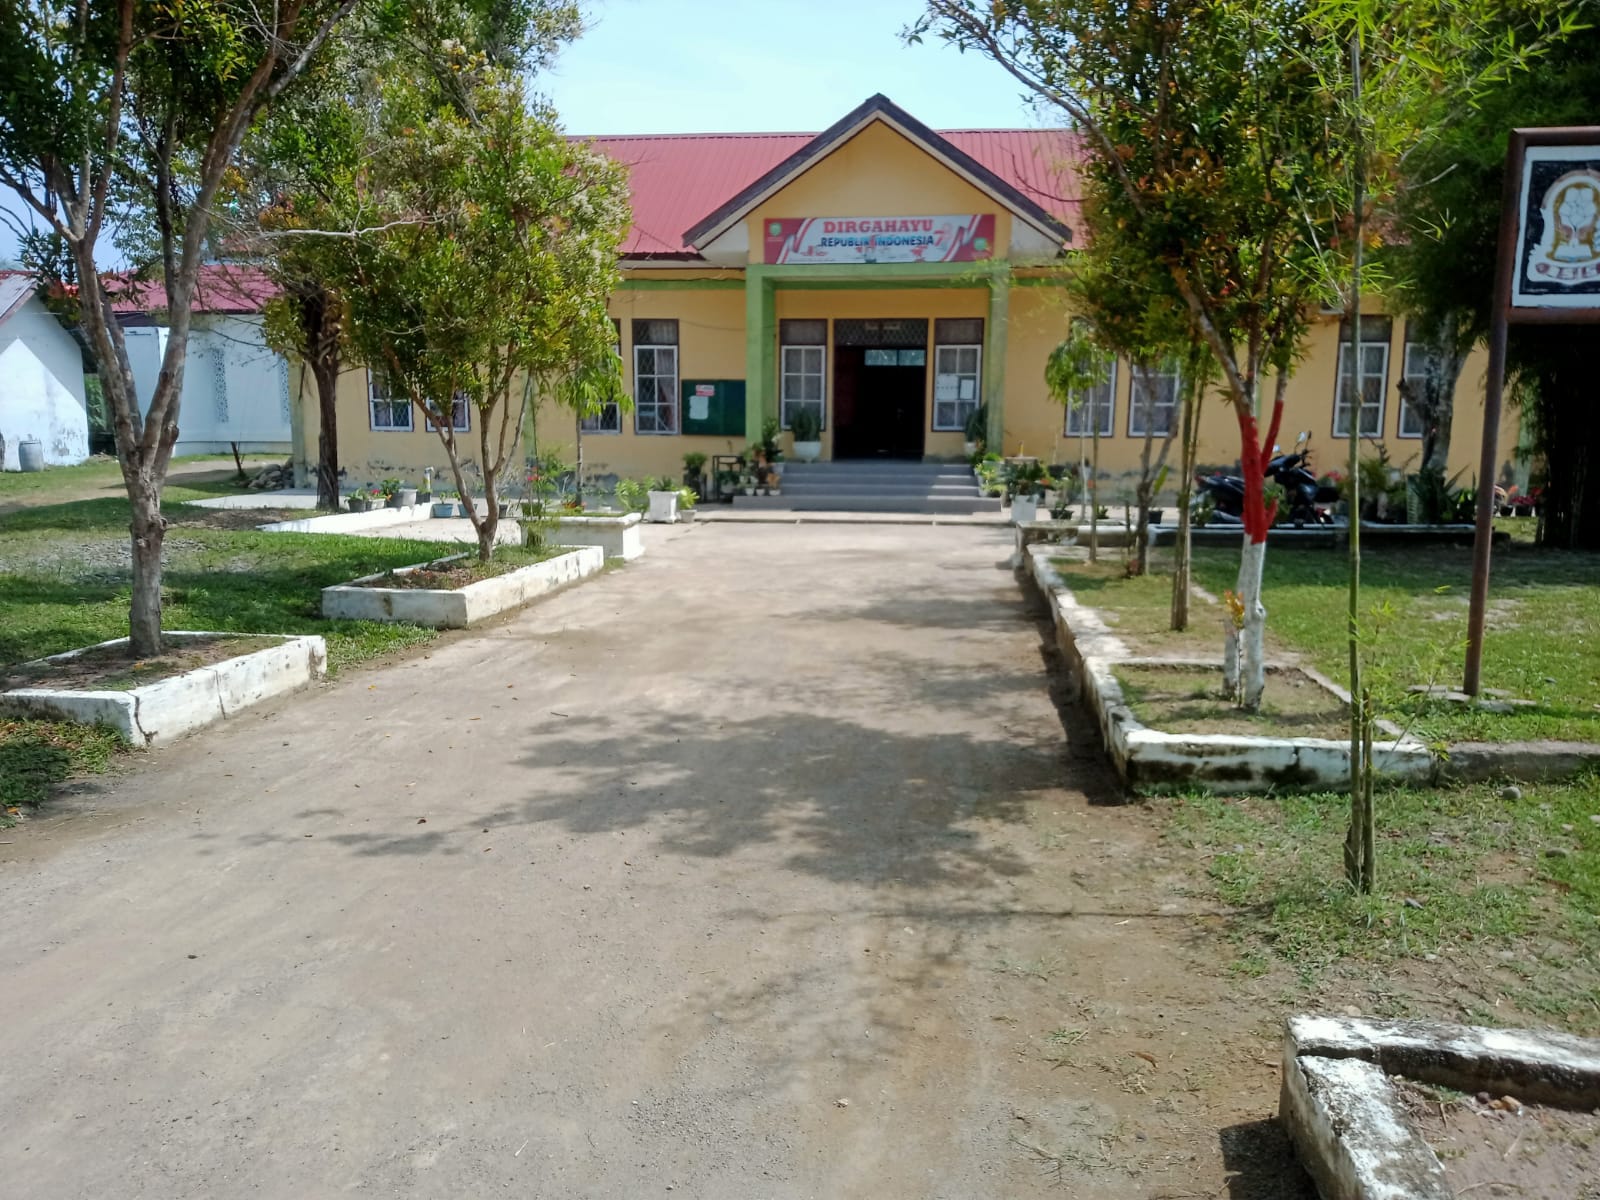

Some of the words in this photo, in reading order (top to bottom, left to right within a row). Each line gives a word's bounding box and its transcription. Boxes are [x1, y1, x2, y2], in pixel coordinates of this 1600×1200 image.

[823, 219, 934, 234] DIRGAHAYU
[820, 235, 870, 247] REPUBLIK
[875, 235, 935, 247] INDONESIA
